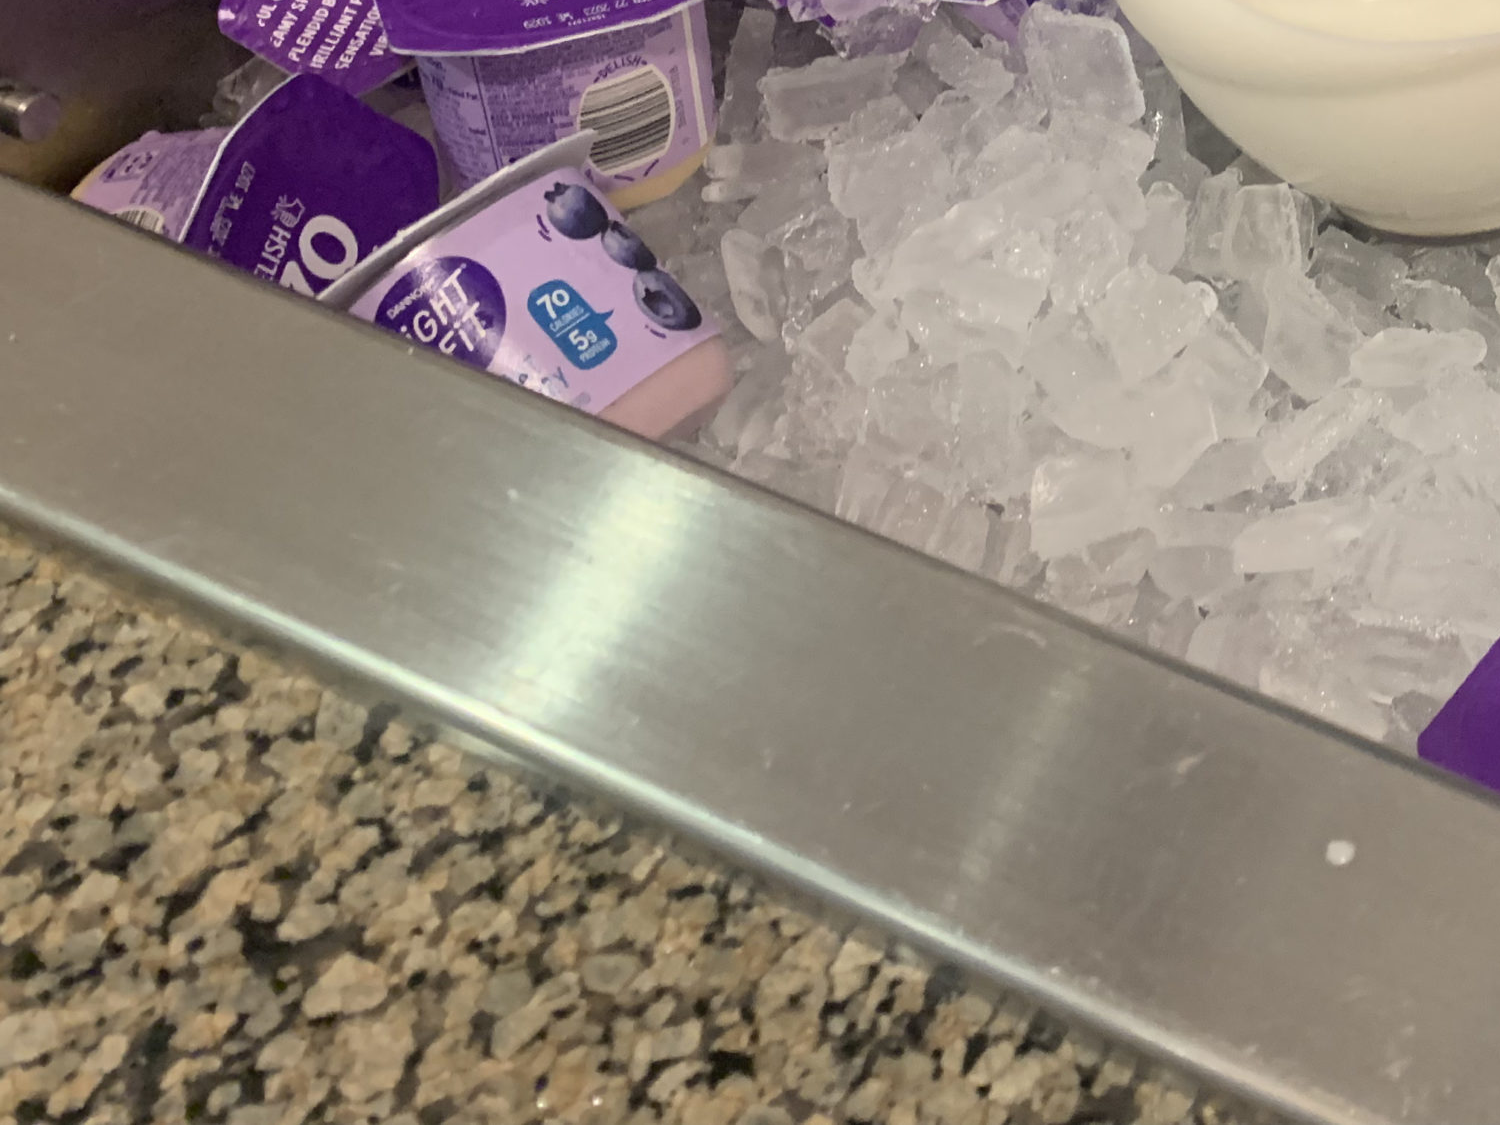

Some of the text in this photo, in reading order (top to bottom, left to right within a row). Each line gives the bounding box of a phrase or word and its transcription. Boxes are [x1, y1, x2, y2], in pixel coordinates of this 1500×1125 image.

[536, 289, 570, 319] 70
[549, 305, 585, 332] CALORIES
[568, 329, 598, 351] 5g
